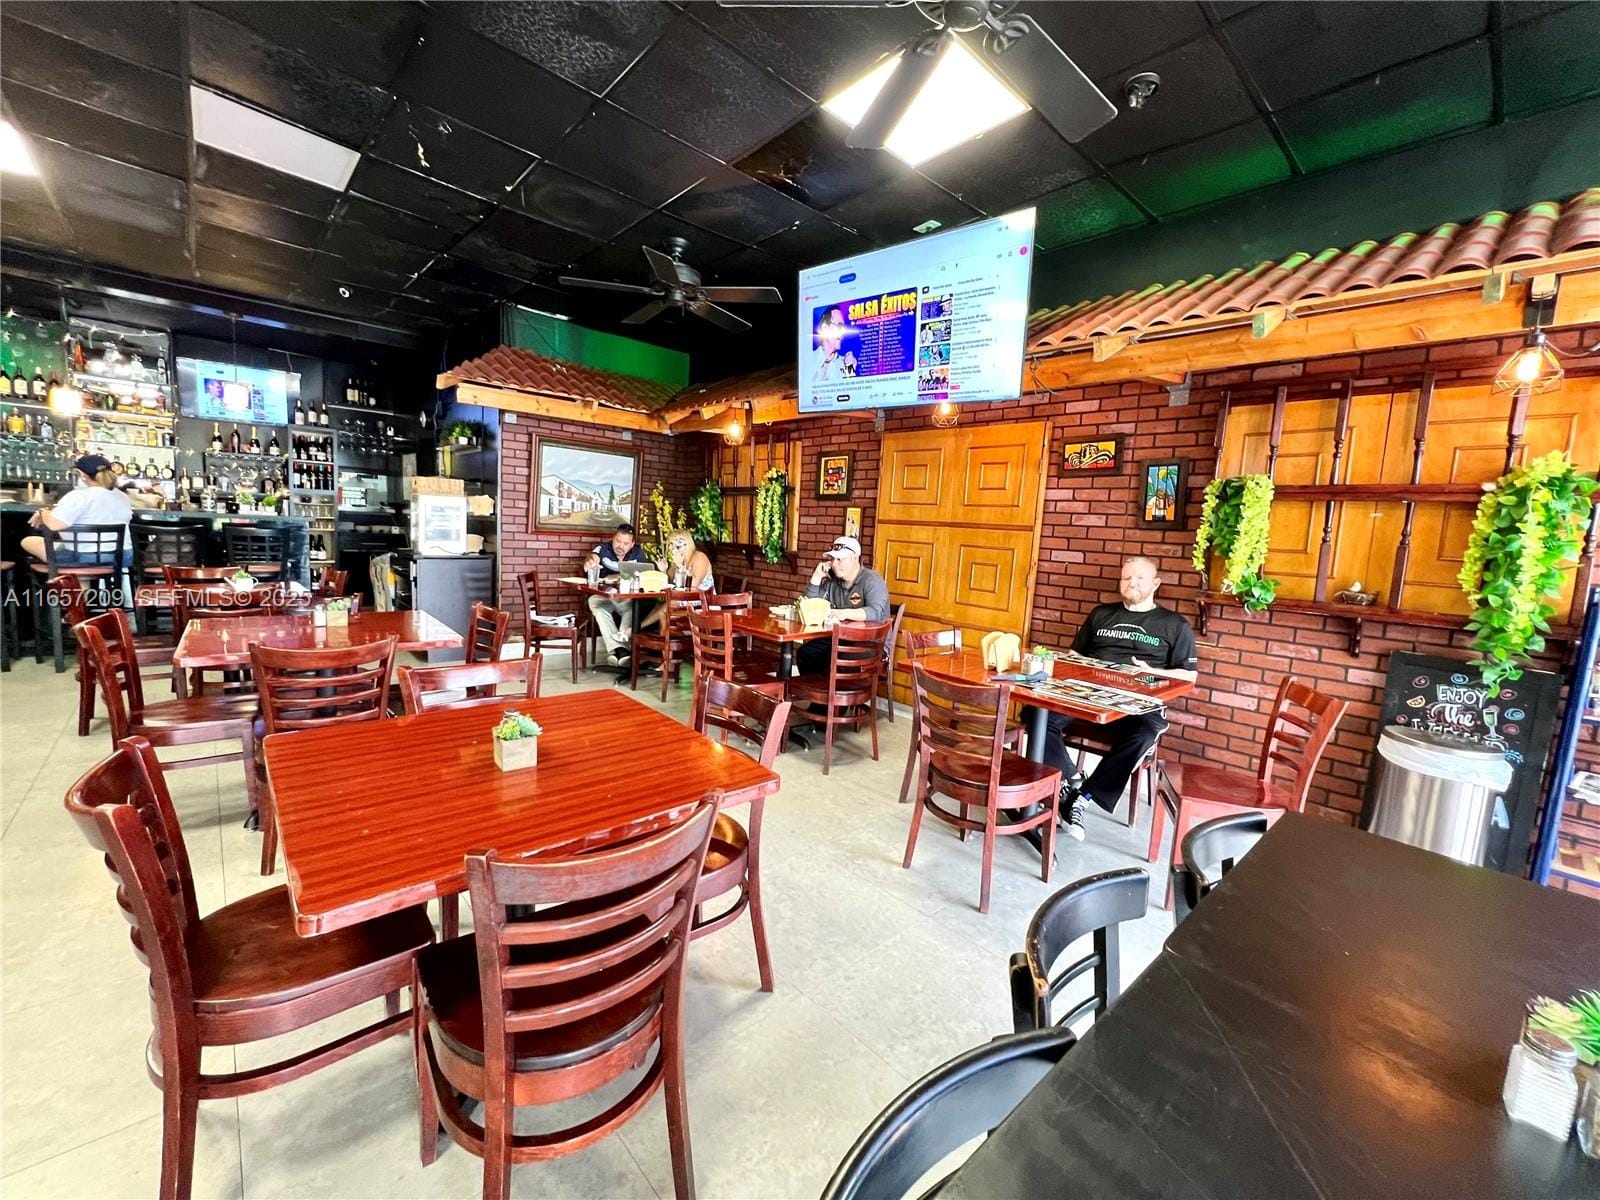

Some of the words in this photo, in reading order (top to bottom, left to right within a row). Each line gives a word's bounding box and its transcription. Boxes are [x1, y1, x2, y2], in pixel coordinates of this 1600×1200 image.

[848, 299, 879, 321] SALSA
[881, 291, 917, 315] ÉXITOS
[1438, 686, 1488, 709] ENJOY
[1431, 703, 1476, 727] The
